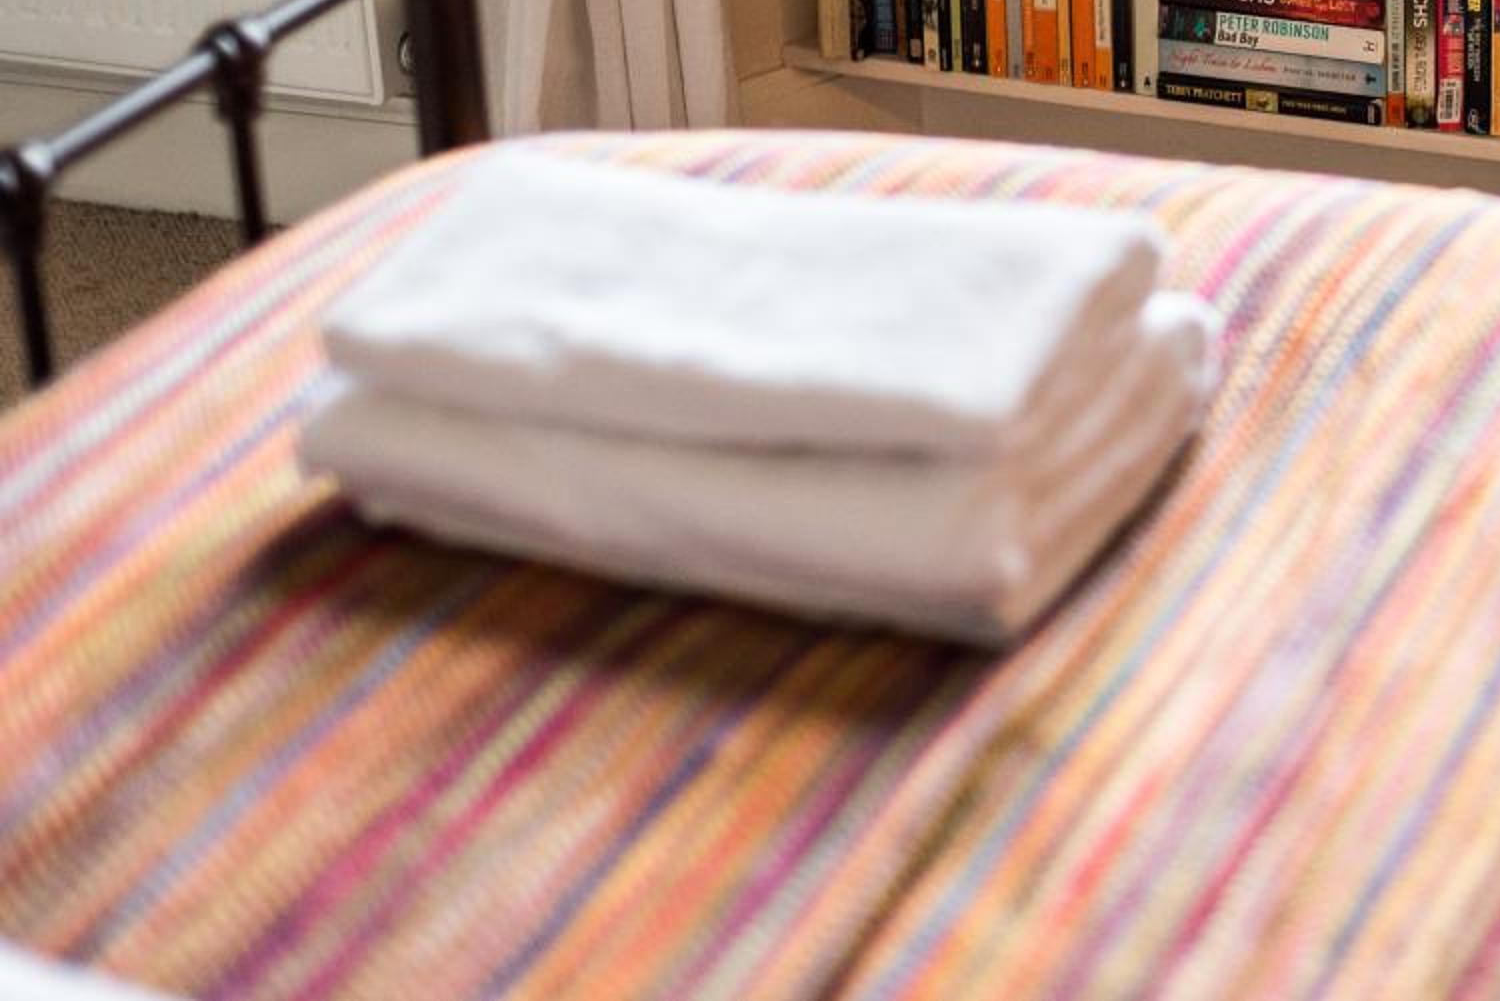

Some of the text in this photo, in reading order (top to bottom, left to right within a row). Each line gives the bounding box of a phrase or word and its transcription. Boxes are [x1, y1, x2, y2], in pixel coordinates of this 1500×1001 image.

[1217, 30, 1259, 48] Bad Boy
[1219, 15, 1329, 41] PETER ROBINSON
